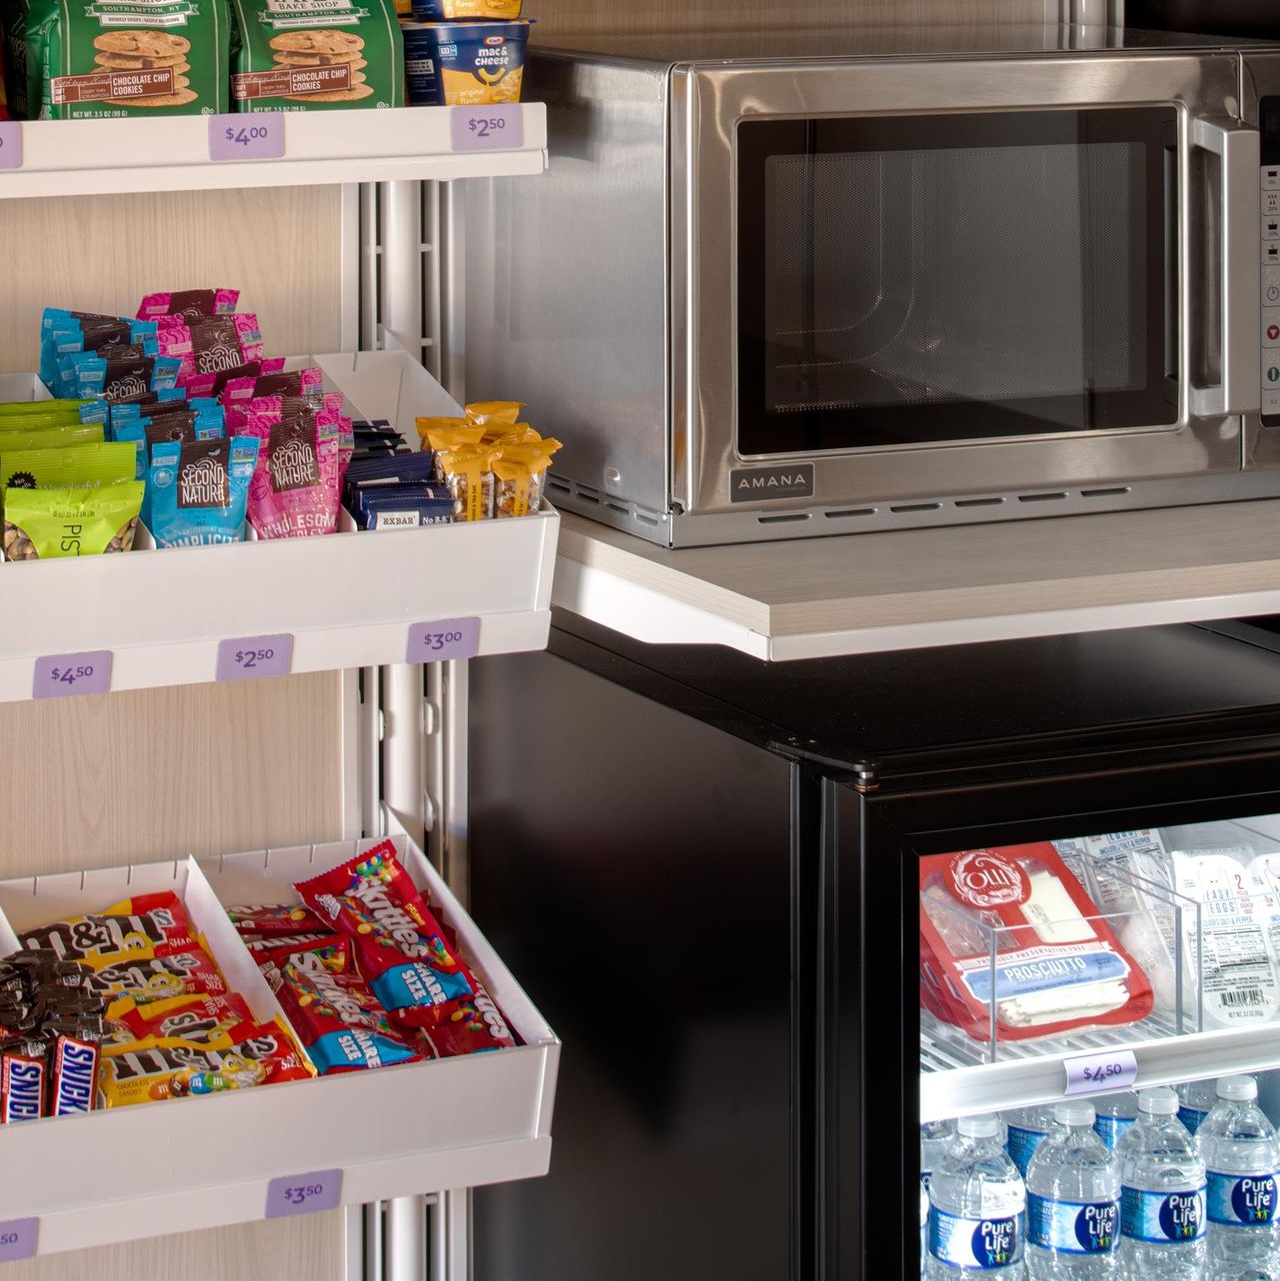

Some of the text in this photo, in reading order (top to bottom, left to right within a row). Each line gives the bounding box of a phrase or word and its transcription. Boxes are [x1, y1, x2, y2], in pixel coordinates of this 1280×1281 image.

[113, 72, 170, 86] CHOCOLATE CHIP
[113, 85, 143, 95] COOKIES
[180, 466, 225, 487] SECOND
[738, 474, 806, 490] AMANA
[182, 482, 225, 504] NATURE
[383, 517, 415, 526] RXBAR
[966, 869, 1010, 890] OLLI
[345, 877, 427, 959] Skittles
[1004, 957, 1087, 981] PROSCIUTTO
[401, 969, 426, 1001] SIZE
[413, 961, 446, 1005] SHARE
[1240, 1177, 1274, 1196] Pure
[1244, 1190, 1272, 1210] Life
[1084, 1205, 1116, 1225] Pure
[981, 1218, 1013, 1238] Pure
[1087, 1219, 1115, 1239] Life
[984, 1234, 1011, 1254] Life
